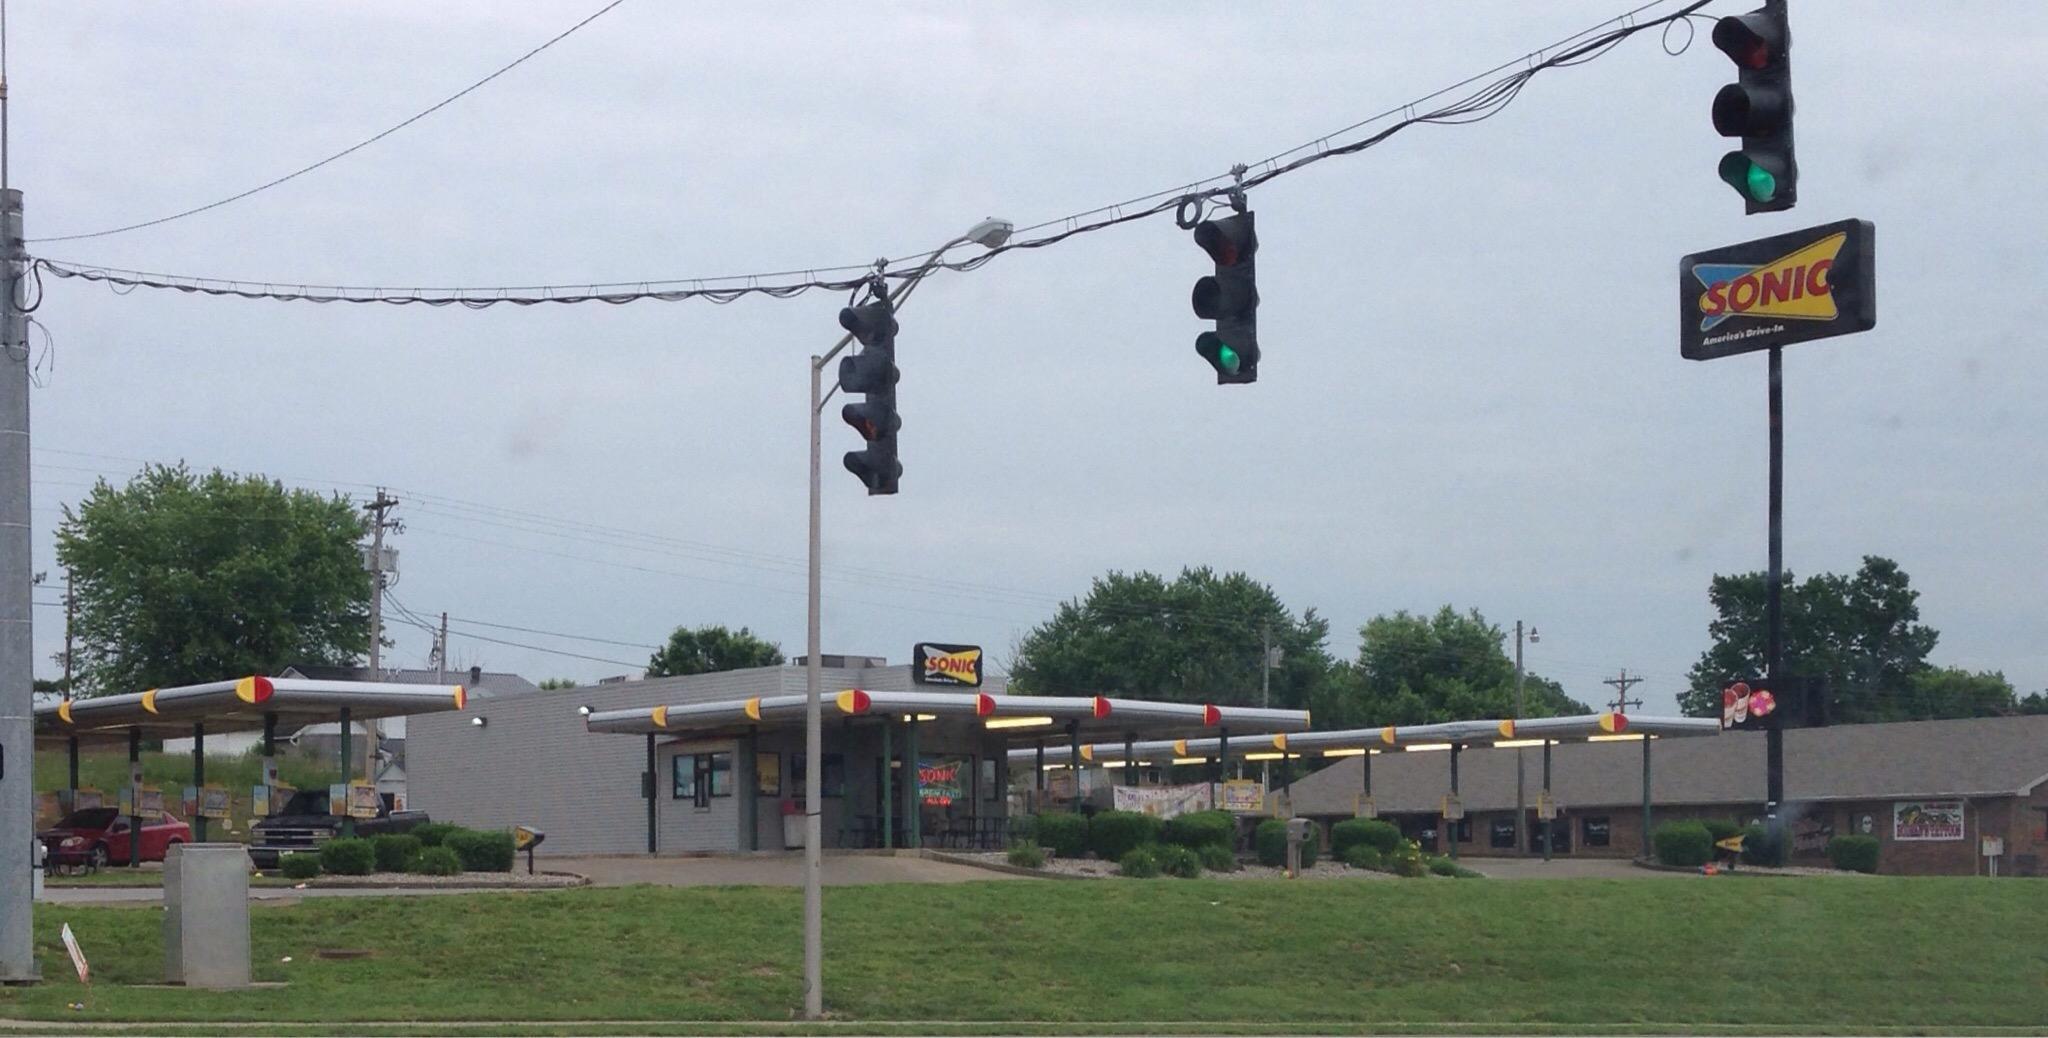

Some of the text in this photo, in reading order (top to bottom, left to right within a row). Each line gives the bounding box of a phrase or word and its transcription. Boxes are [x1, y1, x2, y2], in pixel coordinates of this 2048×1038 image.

[1706, 259, 1834, 317] SONIC
[1703, 324, 1785, 346] America's Drive-In
[928, 656, 976, 674] SONIC
[918, 767, 957, 784] SONIC
